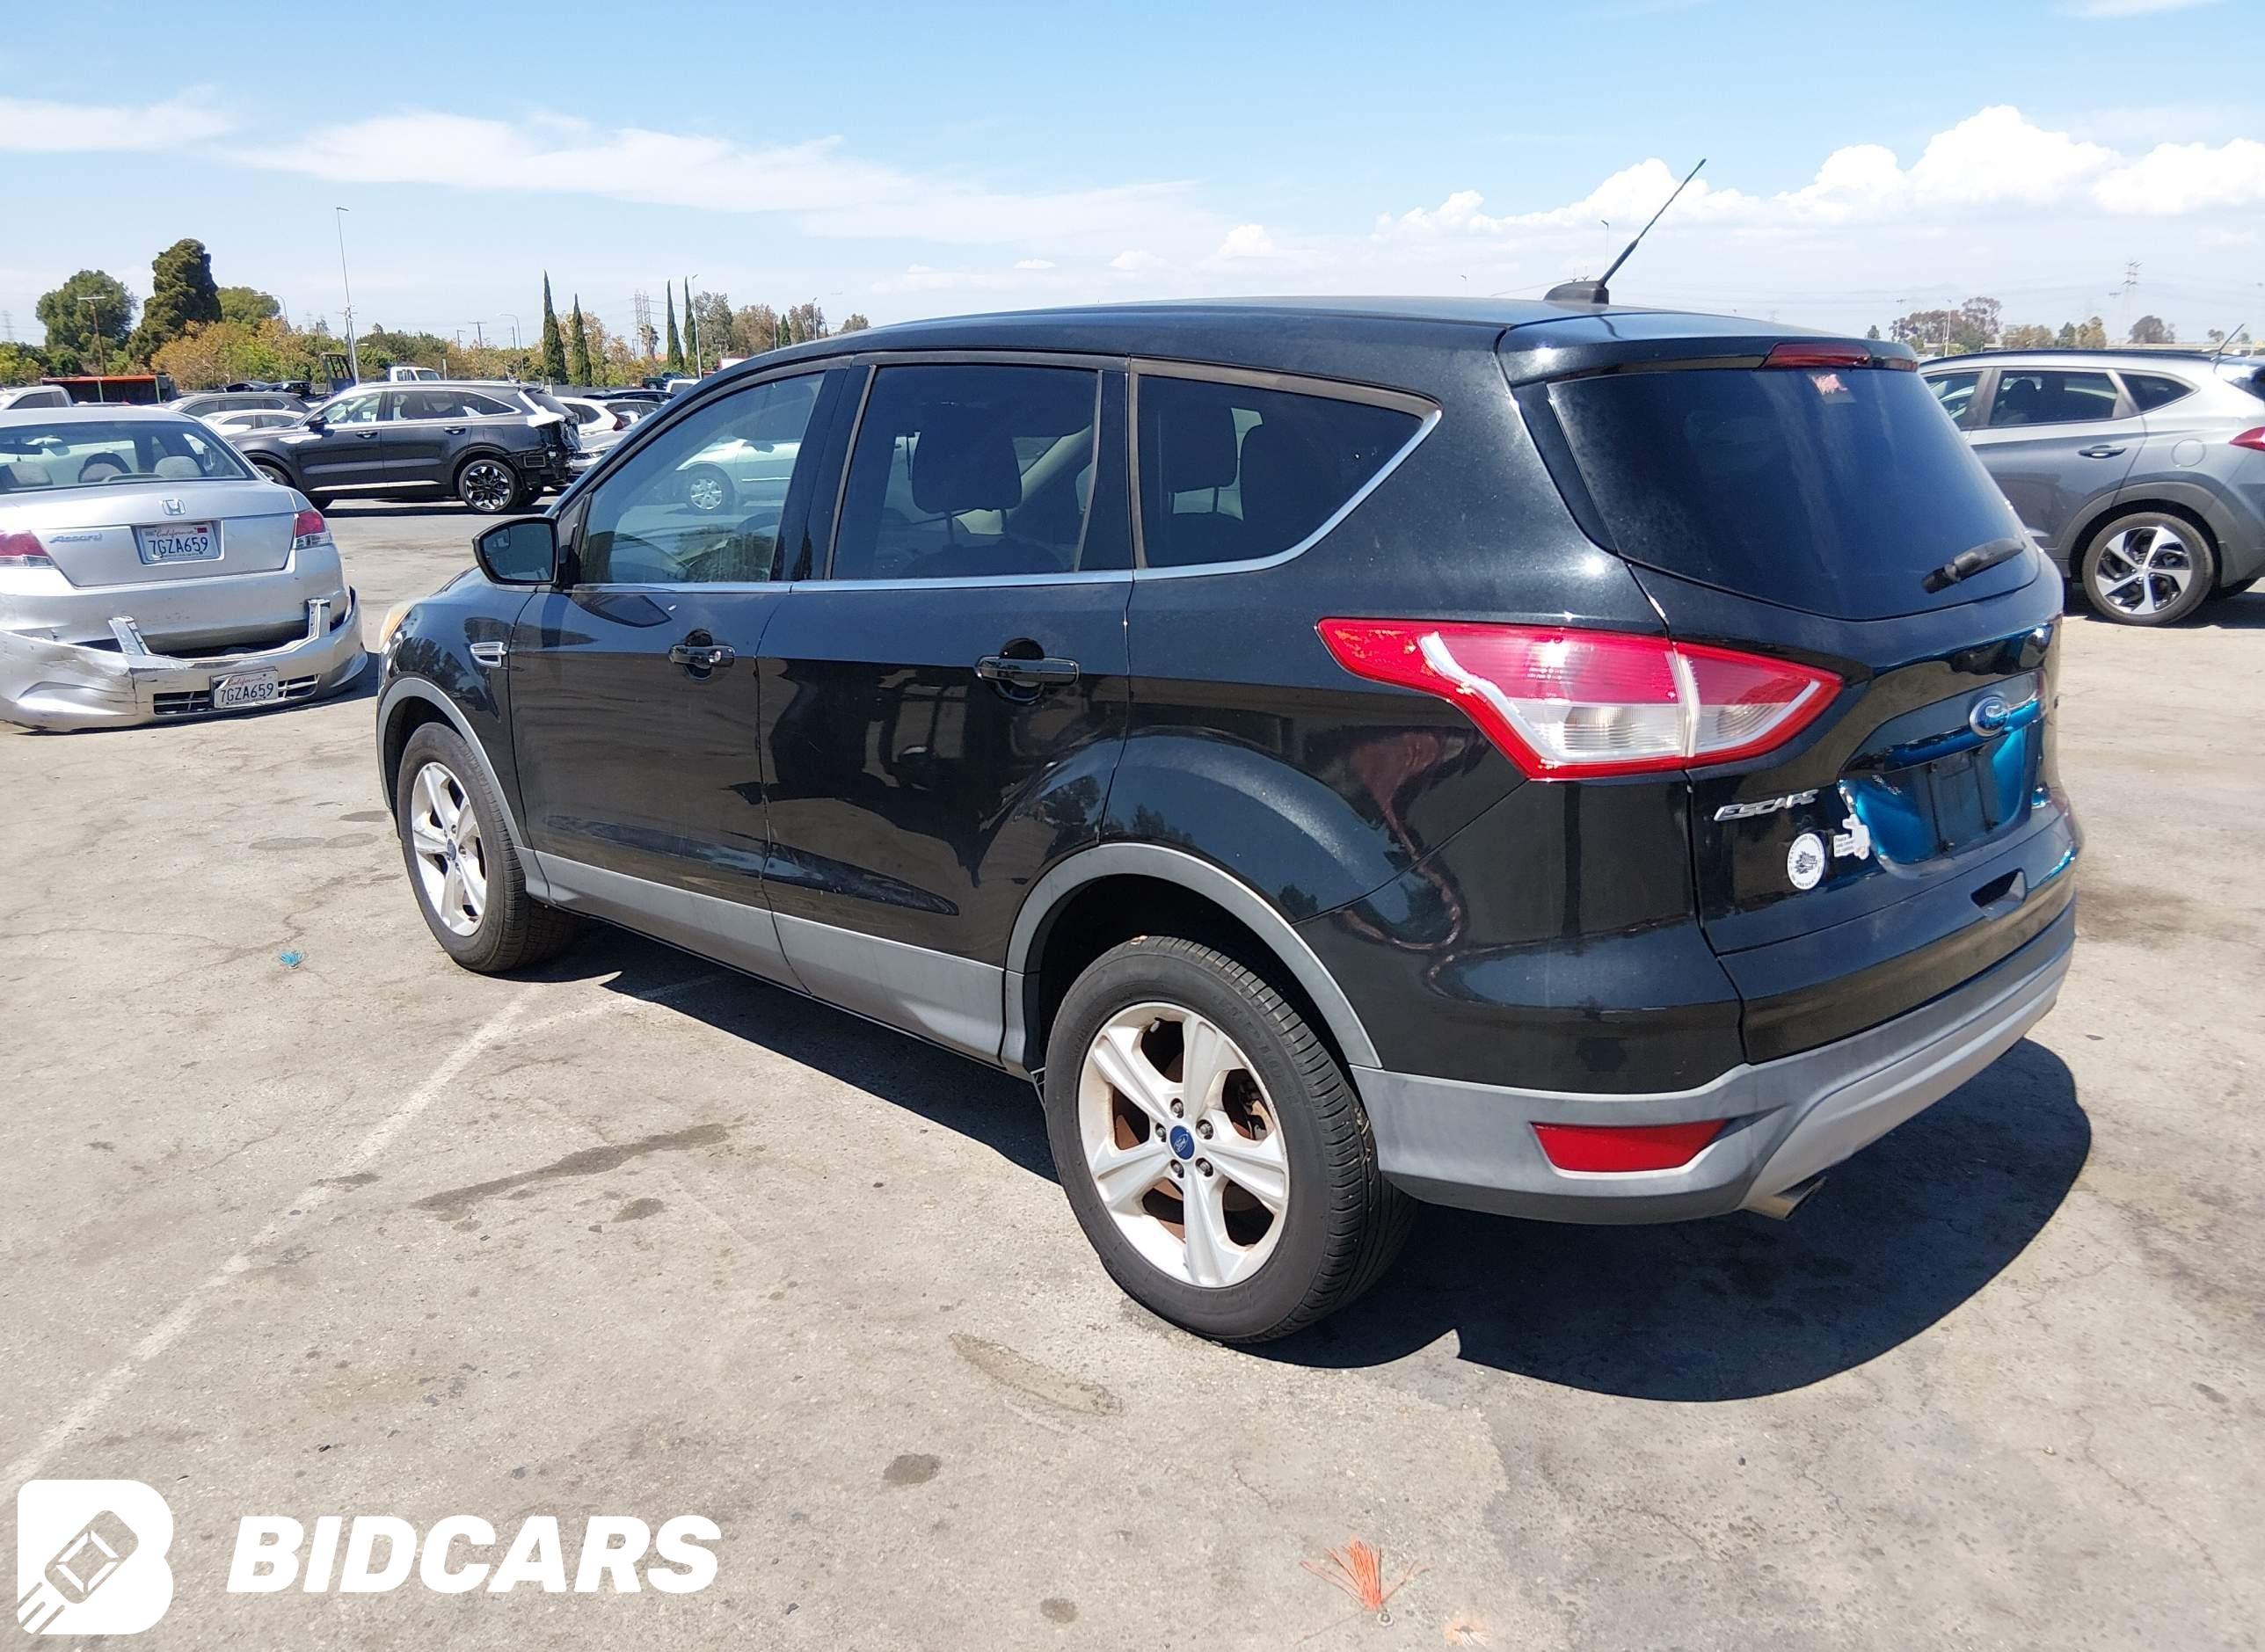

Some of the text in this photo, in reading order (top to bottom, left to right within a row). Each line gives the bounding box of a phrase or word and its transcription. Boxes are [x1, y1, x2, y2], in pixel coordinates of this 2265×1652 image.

[148, 536, 208, 557] 7GZA659
[221, 682, 274, 703] 7GZA659
[1713, 789, 1819, 822] ESCAPE
